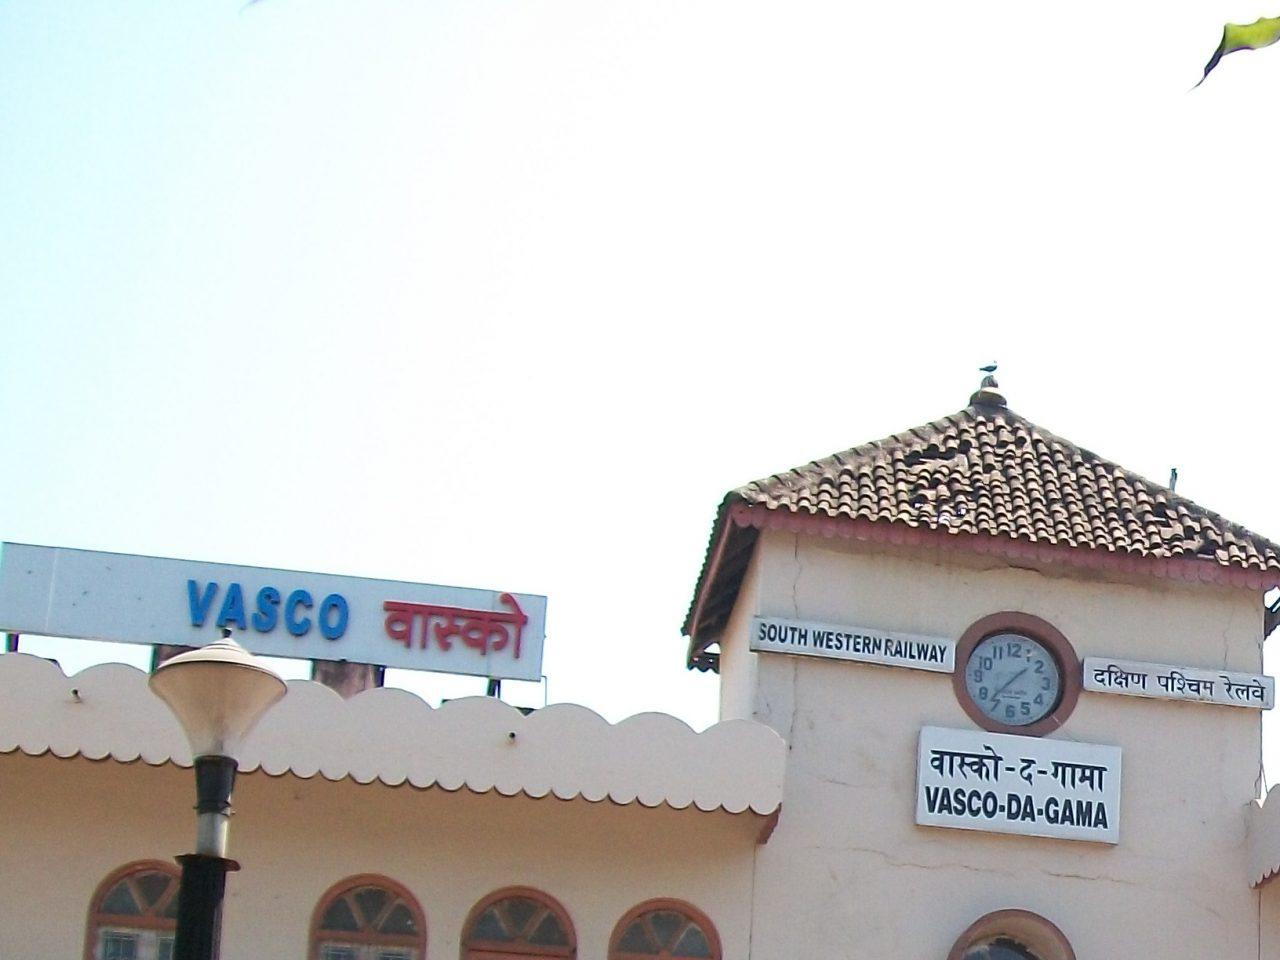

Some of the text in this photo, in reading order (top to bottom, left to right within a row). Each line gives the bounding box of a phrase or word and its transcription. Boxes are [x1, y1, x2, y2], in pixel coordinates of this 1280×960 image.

[187, 579, 349, 640] VASCO
[383, 592, 528, 659] वास्को
[759, 622, 947, 663] SOUTH WESTERN RAILWAY
[993, 646, 1003, 660] 11
[1007, 643, 1021, 658] 12
[980, 656, 993, 671] 10
[1034, 660, 1044, 673] 2
[1041, 677, 1050, 691] 3
[1094, 664, 1266, 702] दक्षिण पश्चिम रेलवे
[979, 687, 988, 700] 8
[1005, 705, 1015, 718] 6
[1021, 702, 1030, 716] 5
[925, 786, 1108, 829] VASCO-DA-GAMA
